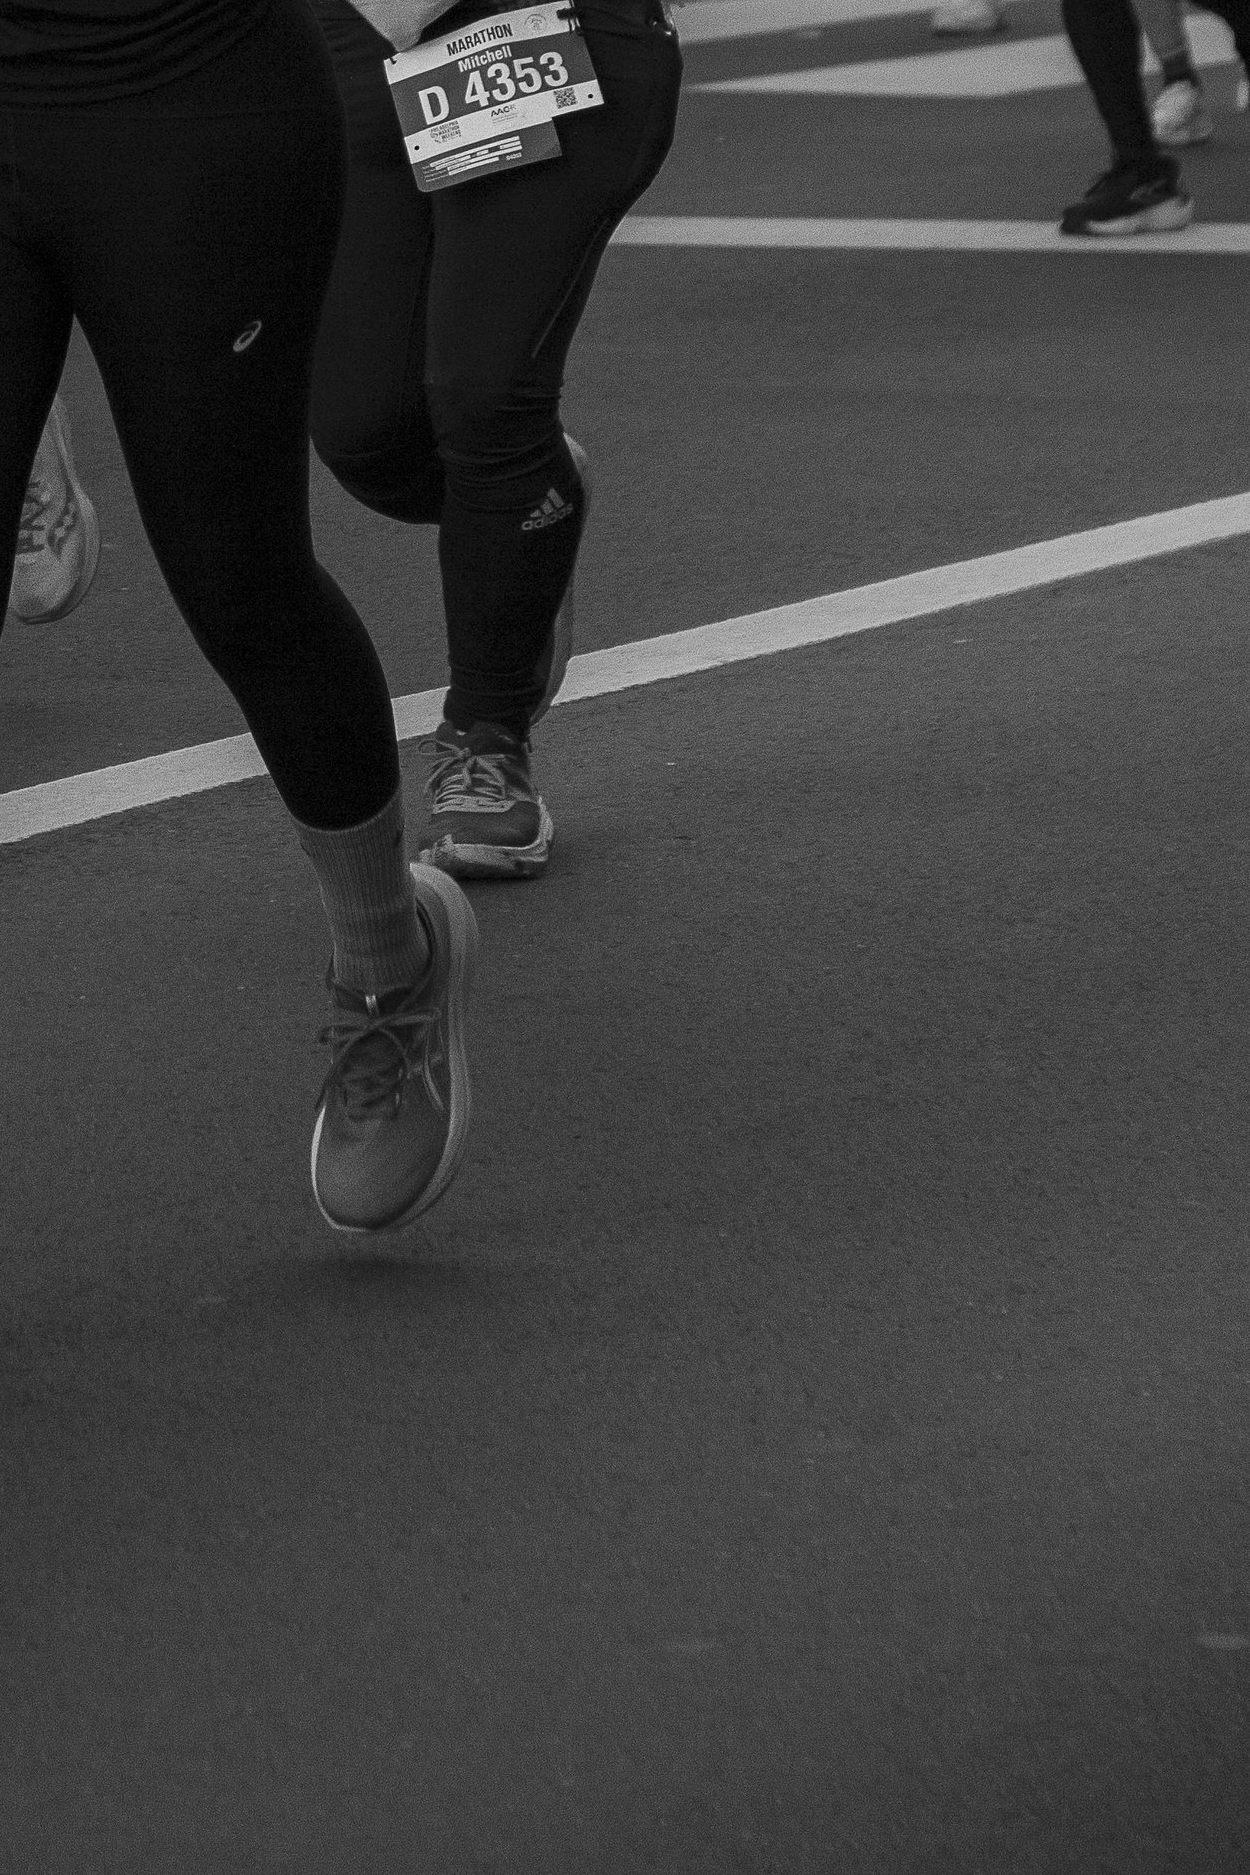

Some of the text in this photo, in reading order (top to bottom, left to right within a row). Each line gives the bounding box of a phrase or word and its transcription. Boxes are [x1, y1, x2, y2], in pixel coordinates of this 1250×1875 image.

[447, 23, 513, 56] MARATHON
[458, 45, 513, 73] Mitchell
[418, 51, 569, 125] D 4353
[521, 503, 574, 531] adidas
